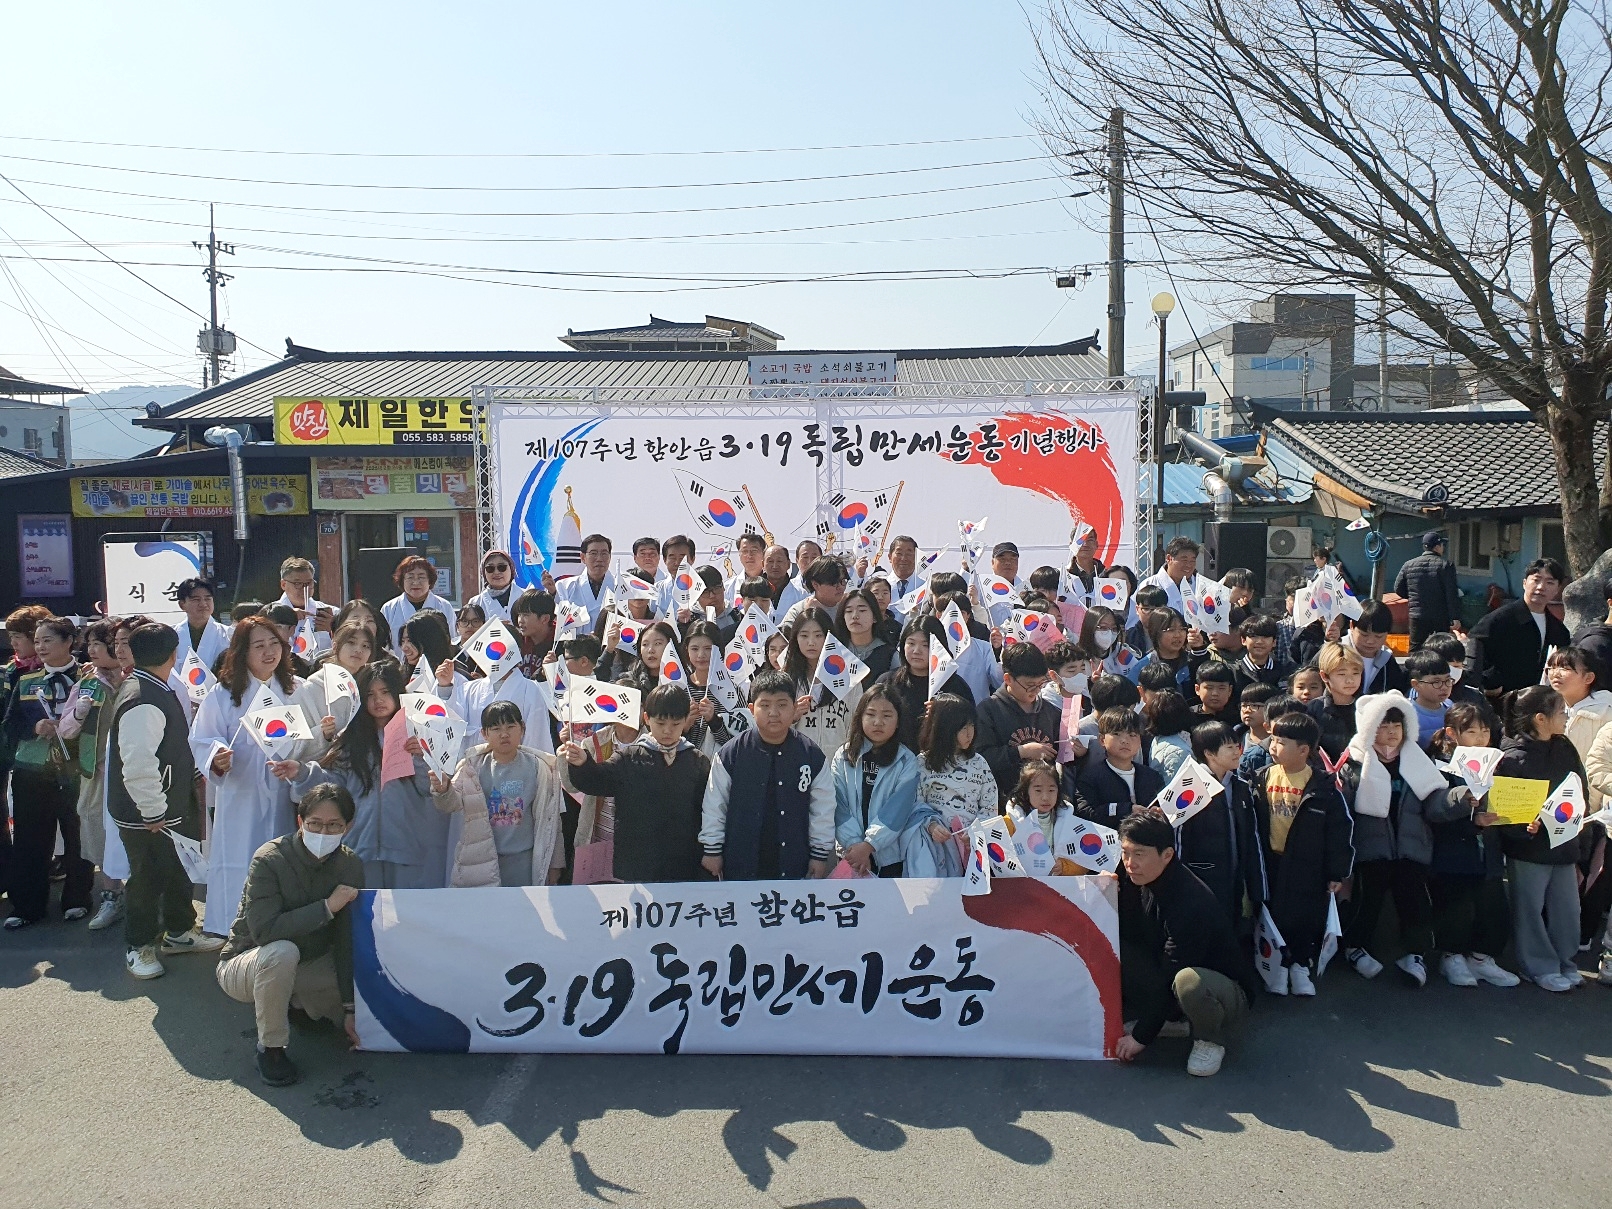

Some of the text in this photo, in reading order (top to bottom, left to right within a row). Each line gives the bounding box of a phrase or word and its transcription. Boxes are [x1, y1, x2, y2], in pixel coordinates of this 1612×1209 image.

[759, 363, 813, 374] 소고기 국밥
[292, 404, 330, 437] 맛집
[524, 436, 639, 462] 제107주년
[643, 436, 717, 463] 함안읍
[1009, 426, 1104, 456] 기념행사
[150, 493, 169, 506] 전통
[599, 888, 867, 931] 제107주년 함안읍
